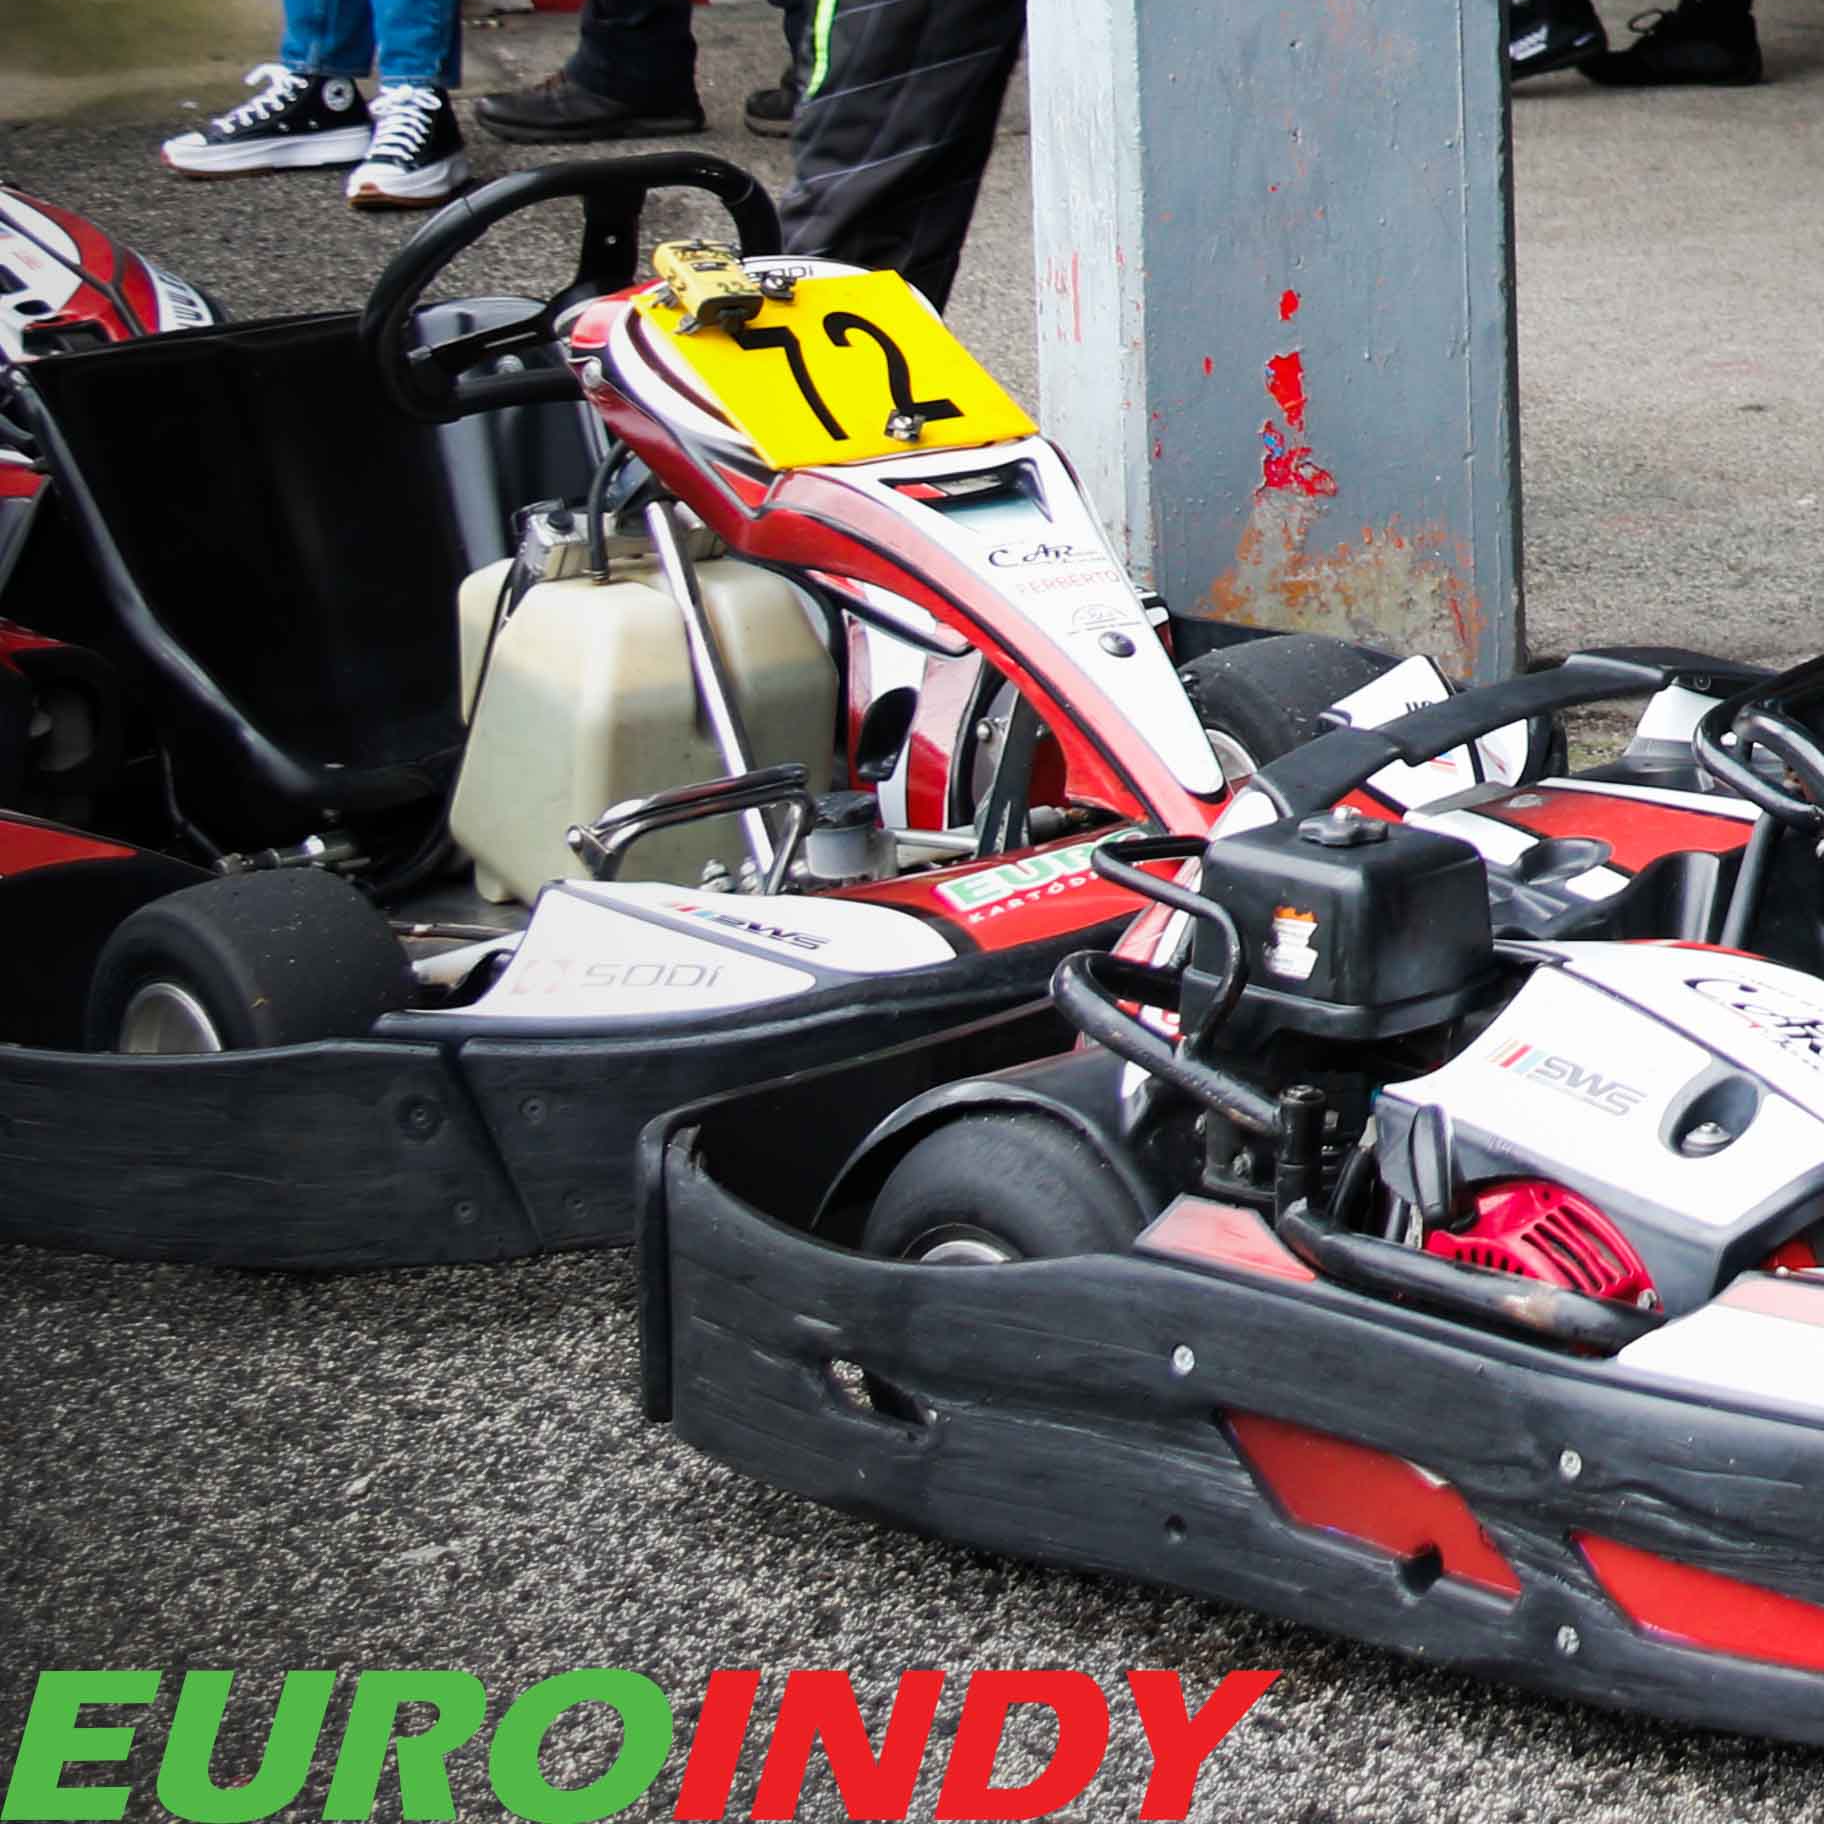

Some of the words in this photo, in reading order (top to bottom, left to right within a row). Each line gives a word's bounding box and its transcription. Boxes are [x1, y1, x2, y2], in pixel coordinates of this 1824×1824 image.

[733, 311, 965, 441] 72
[968, 870, 1100, 924] KARTÓD
[1526, 1054, 1648, 1118] SWS
